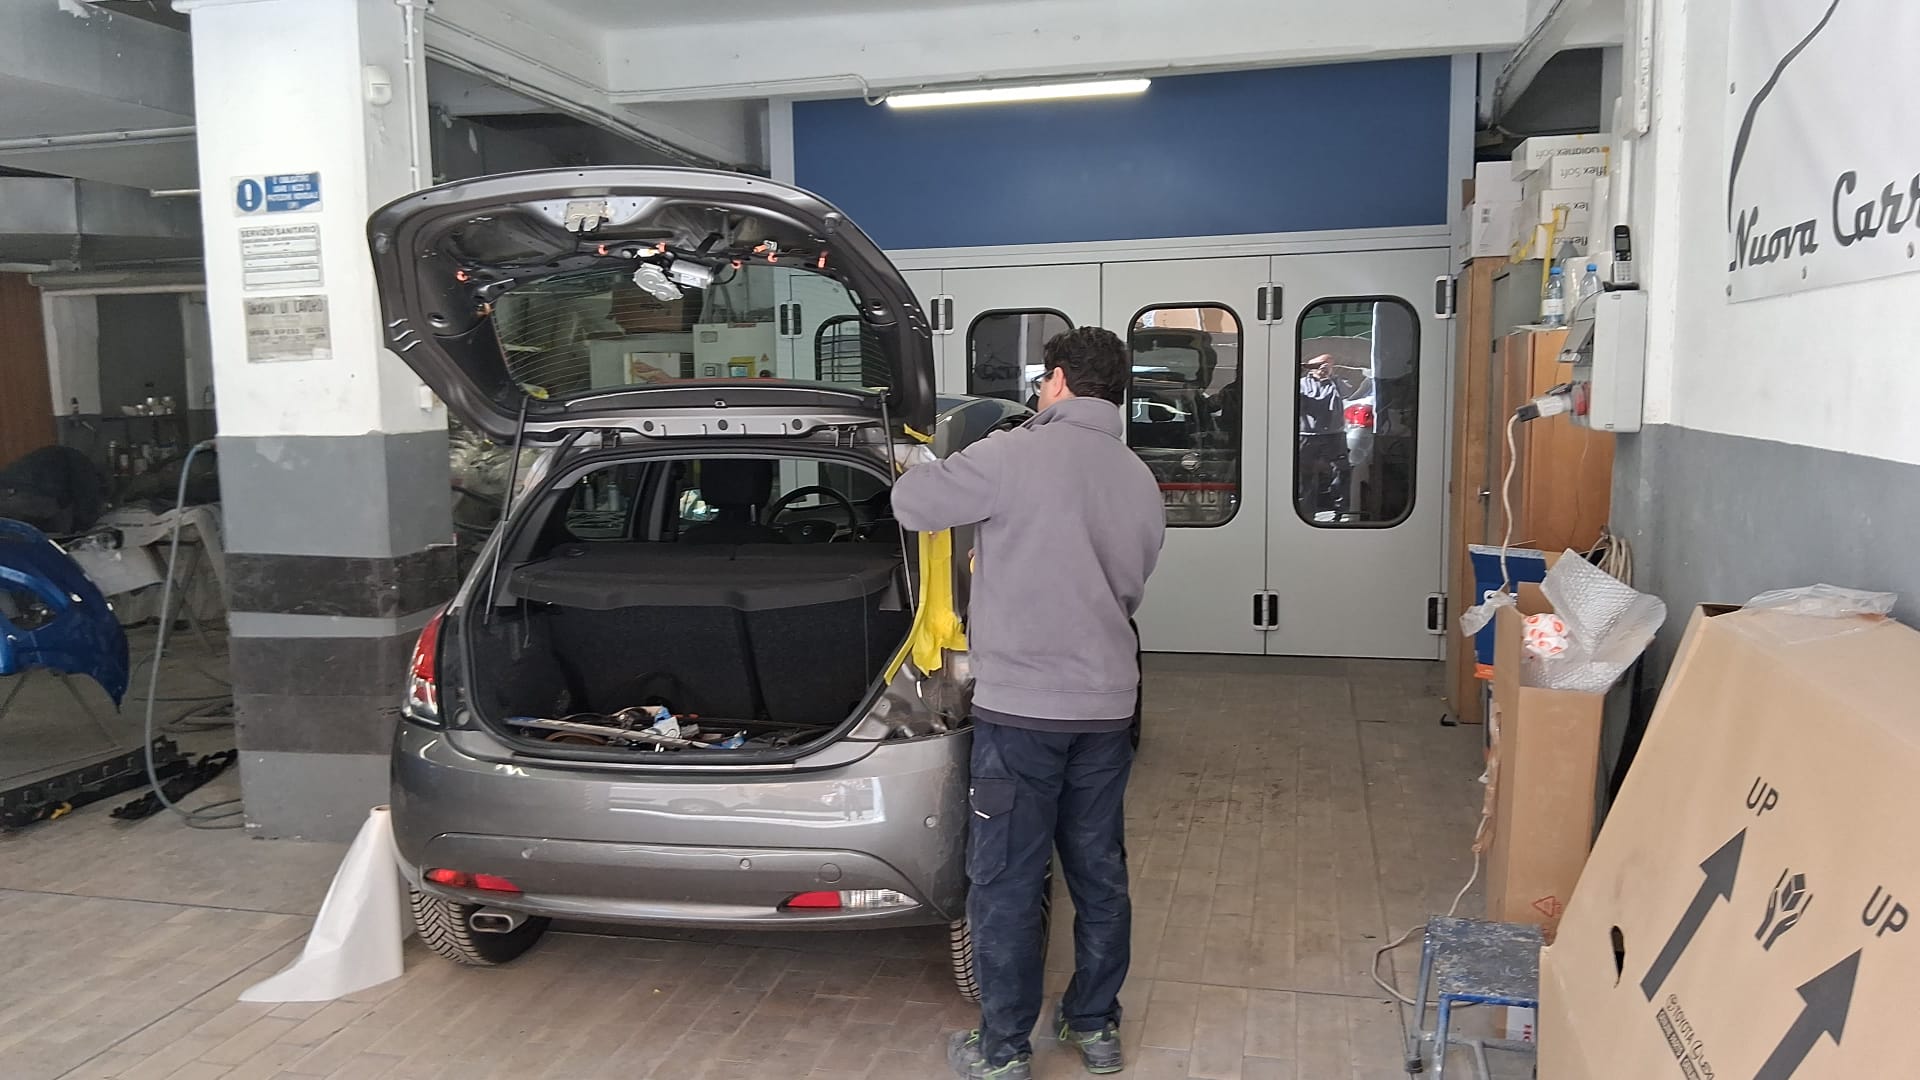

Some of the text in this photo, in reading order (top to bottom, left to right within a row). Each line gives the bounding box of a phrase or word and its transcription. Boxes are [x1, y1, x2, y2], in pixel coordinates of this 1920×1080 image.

[1561, 167, 1581, 178] Soft
[242, 225, 316, 238] SERVIZIO SANITARIO
[1728, 206, 1819, 272] Nuova
[1746, 776, 1778, 816] UP
[1862, 885, 1908, 938] UP
